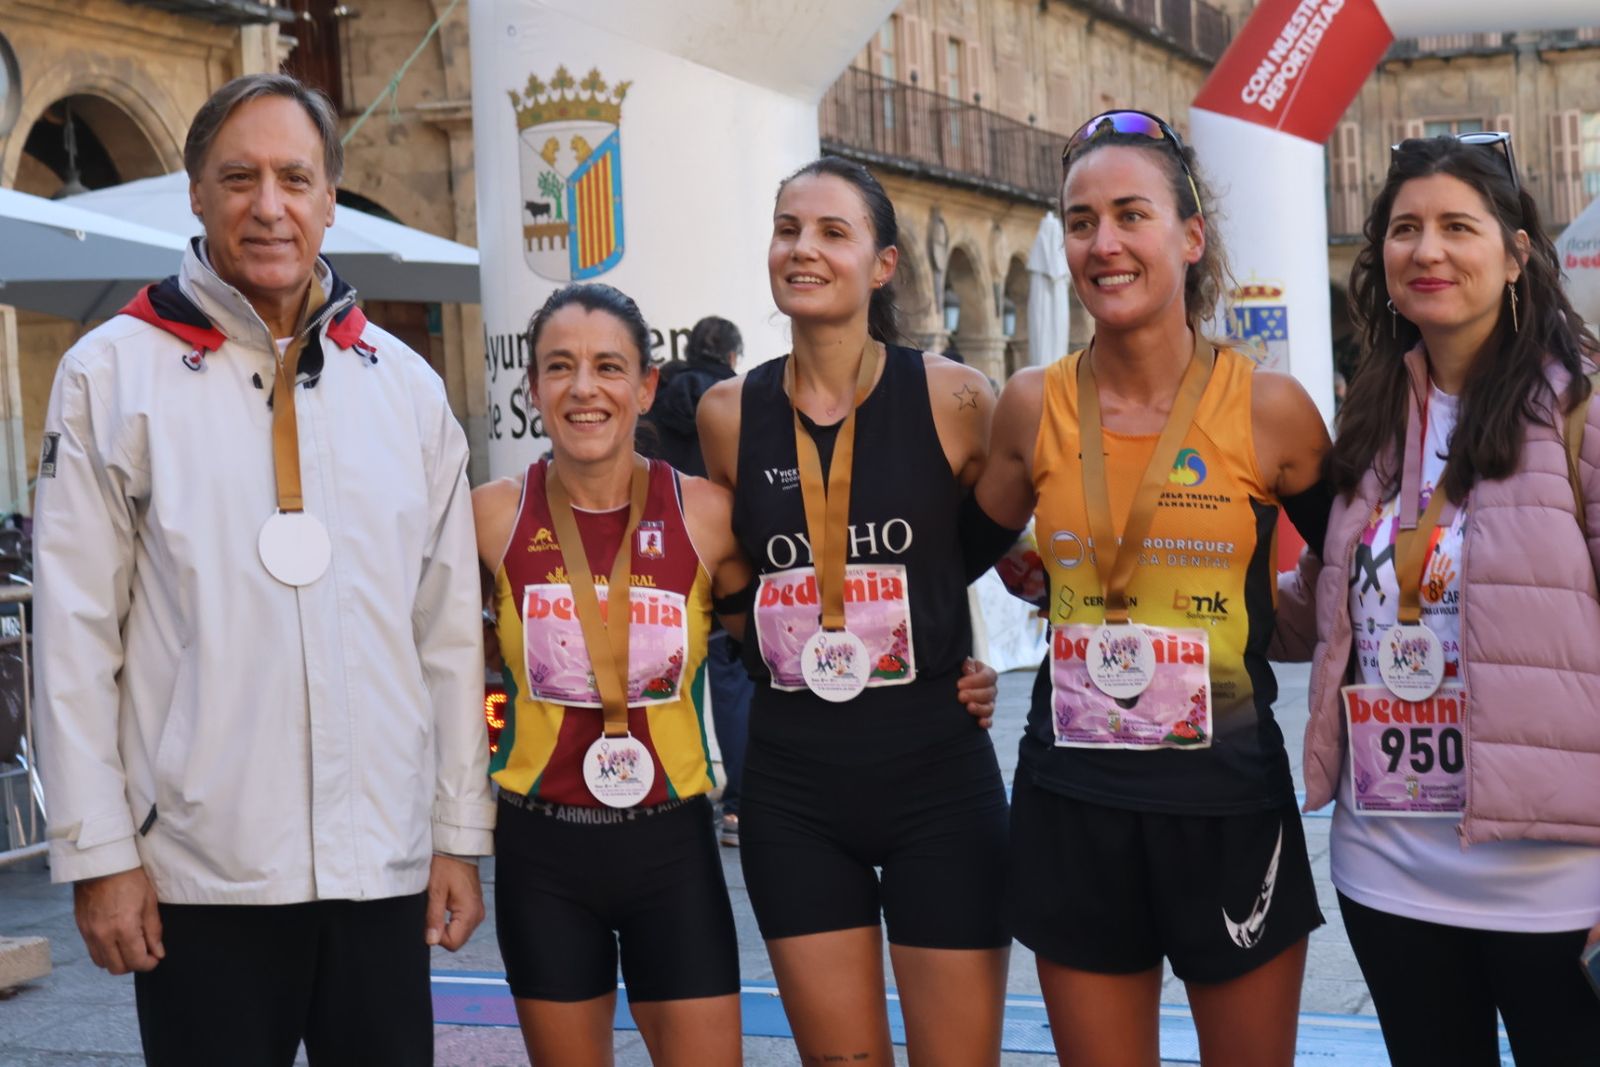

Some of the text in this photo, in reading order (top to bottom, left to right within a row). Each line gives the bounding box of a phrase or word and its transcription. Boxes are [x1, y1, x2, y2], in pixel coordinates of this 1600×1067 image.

[1257, 0, 1345, 112] DEPORTISTAS
[1240, 58, 1277, 104] CON
[766, 517, 914, 569] OYHO
[1167, 554, 1230, 569] DENTAL
[1380, 727, 1465, 774] 950
[556, 806, 624, 825] ARMOUR
